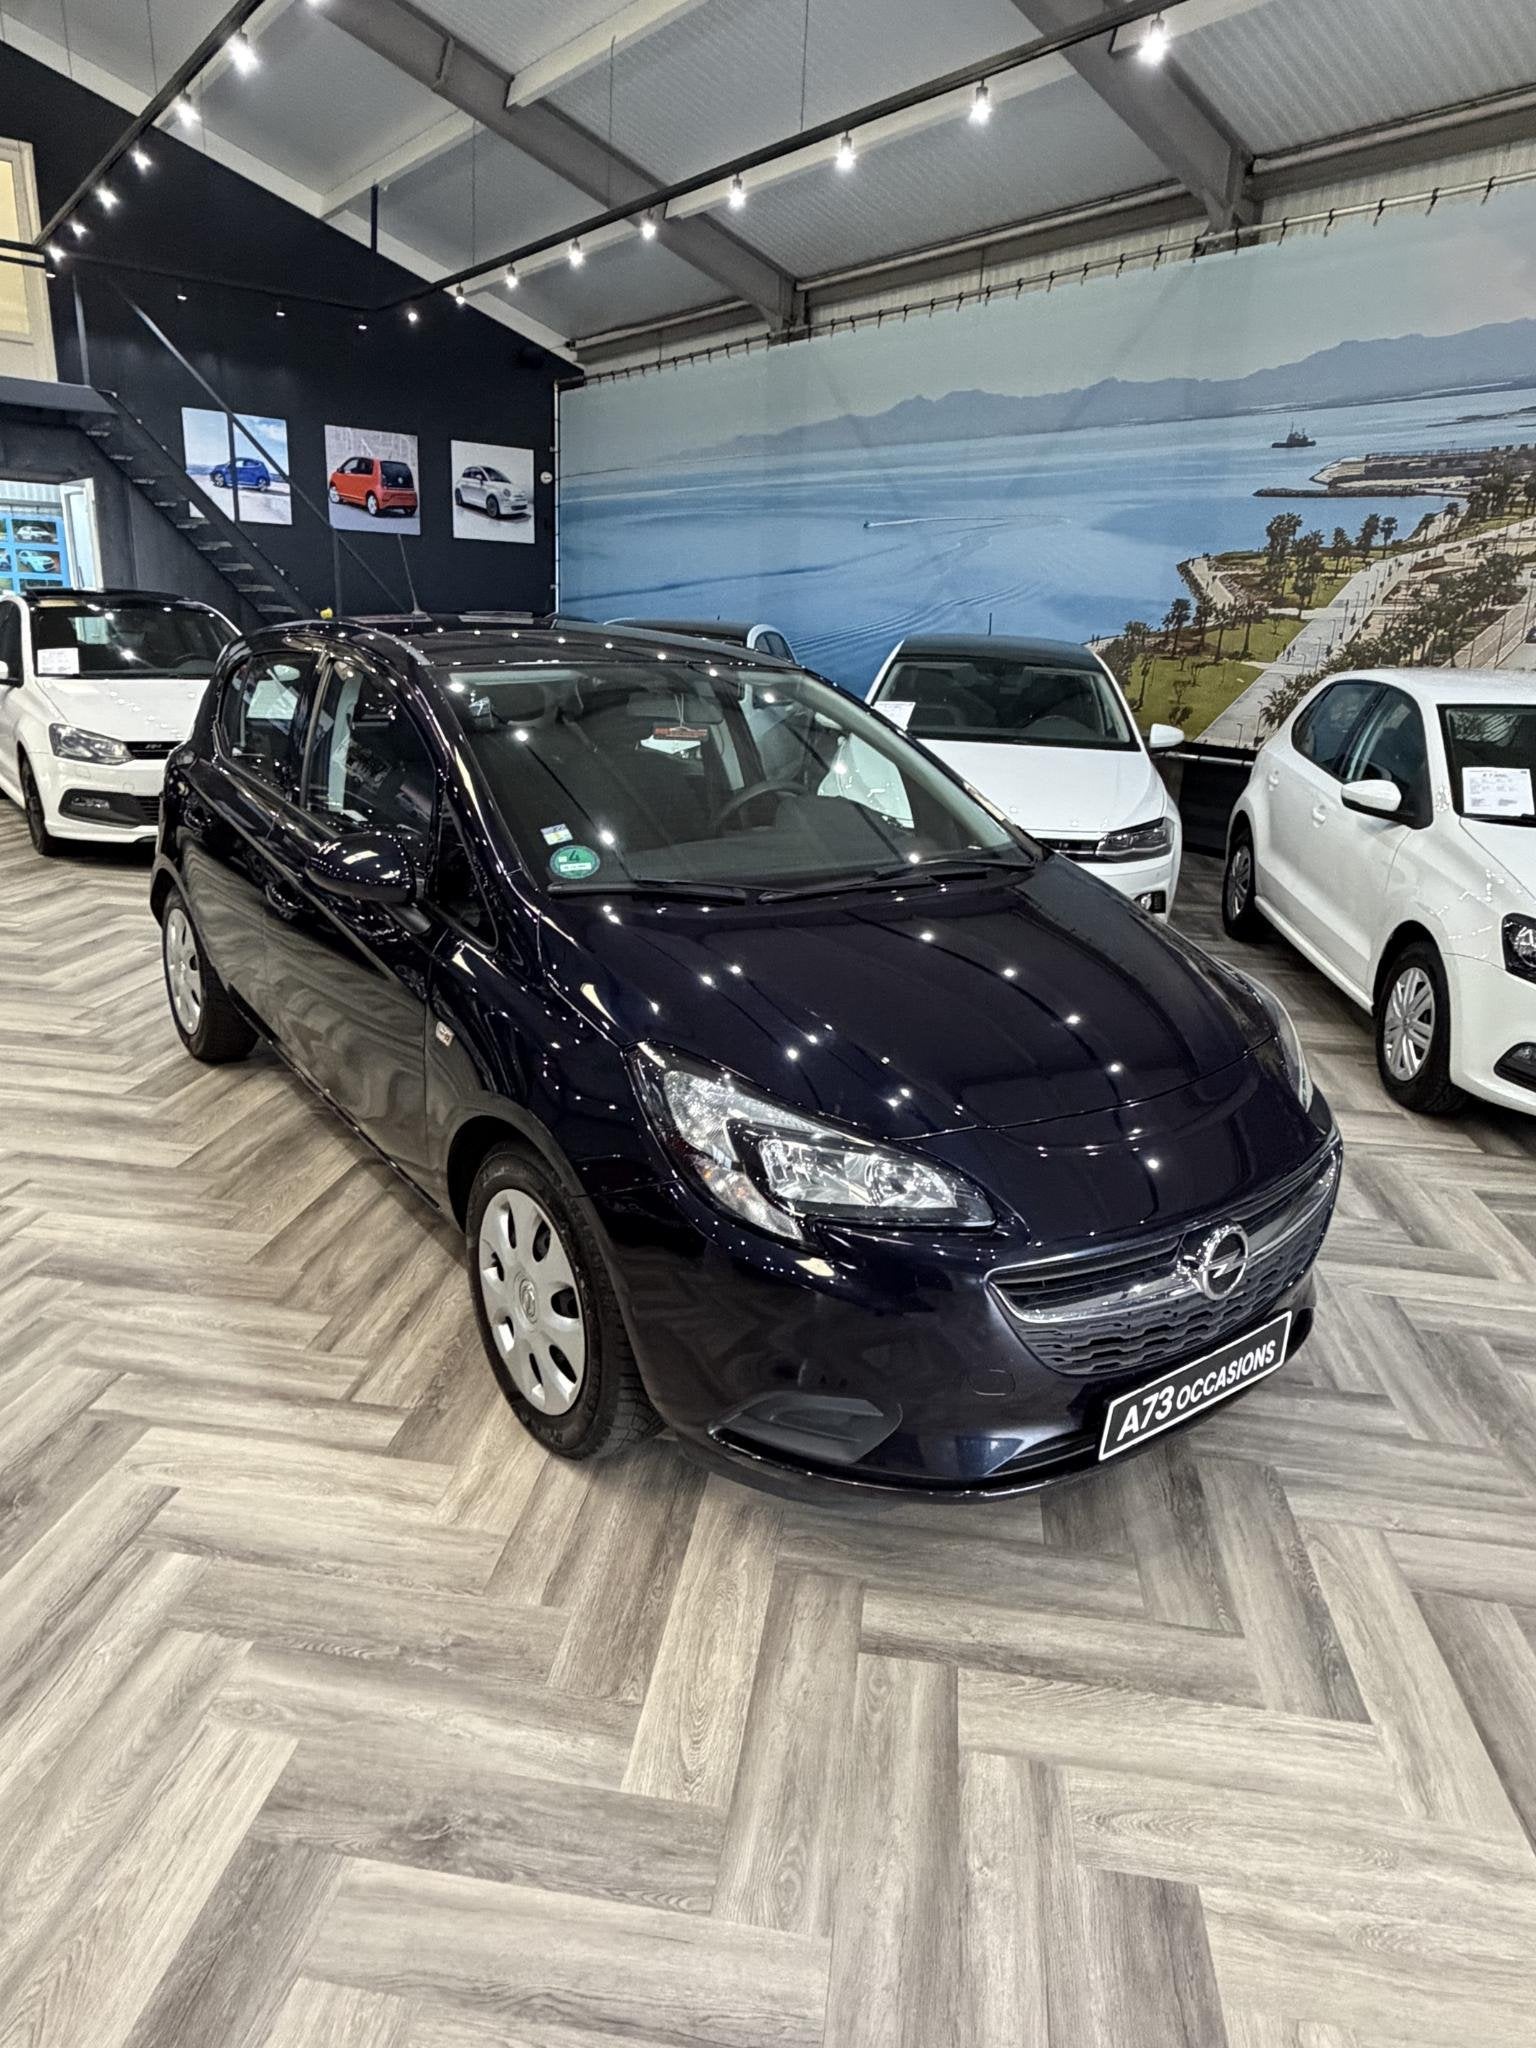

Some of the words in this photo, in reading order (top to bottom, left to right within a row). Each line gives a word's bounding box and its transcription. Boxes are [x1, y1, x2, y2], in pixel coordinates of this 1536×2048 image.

[568, 850, 581, 862] 4
[1117, 1385, 1175, 1441] A73
[1176, 1340, 1276, 1410] OCCASIONS
